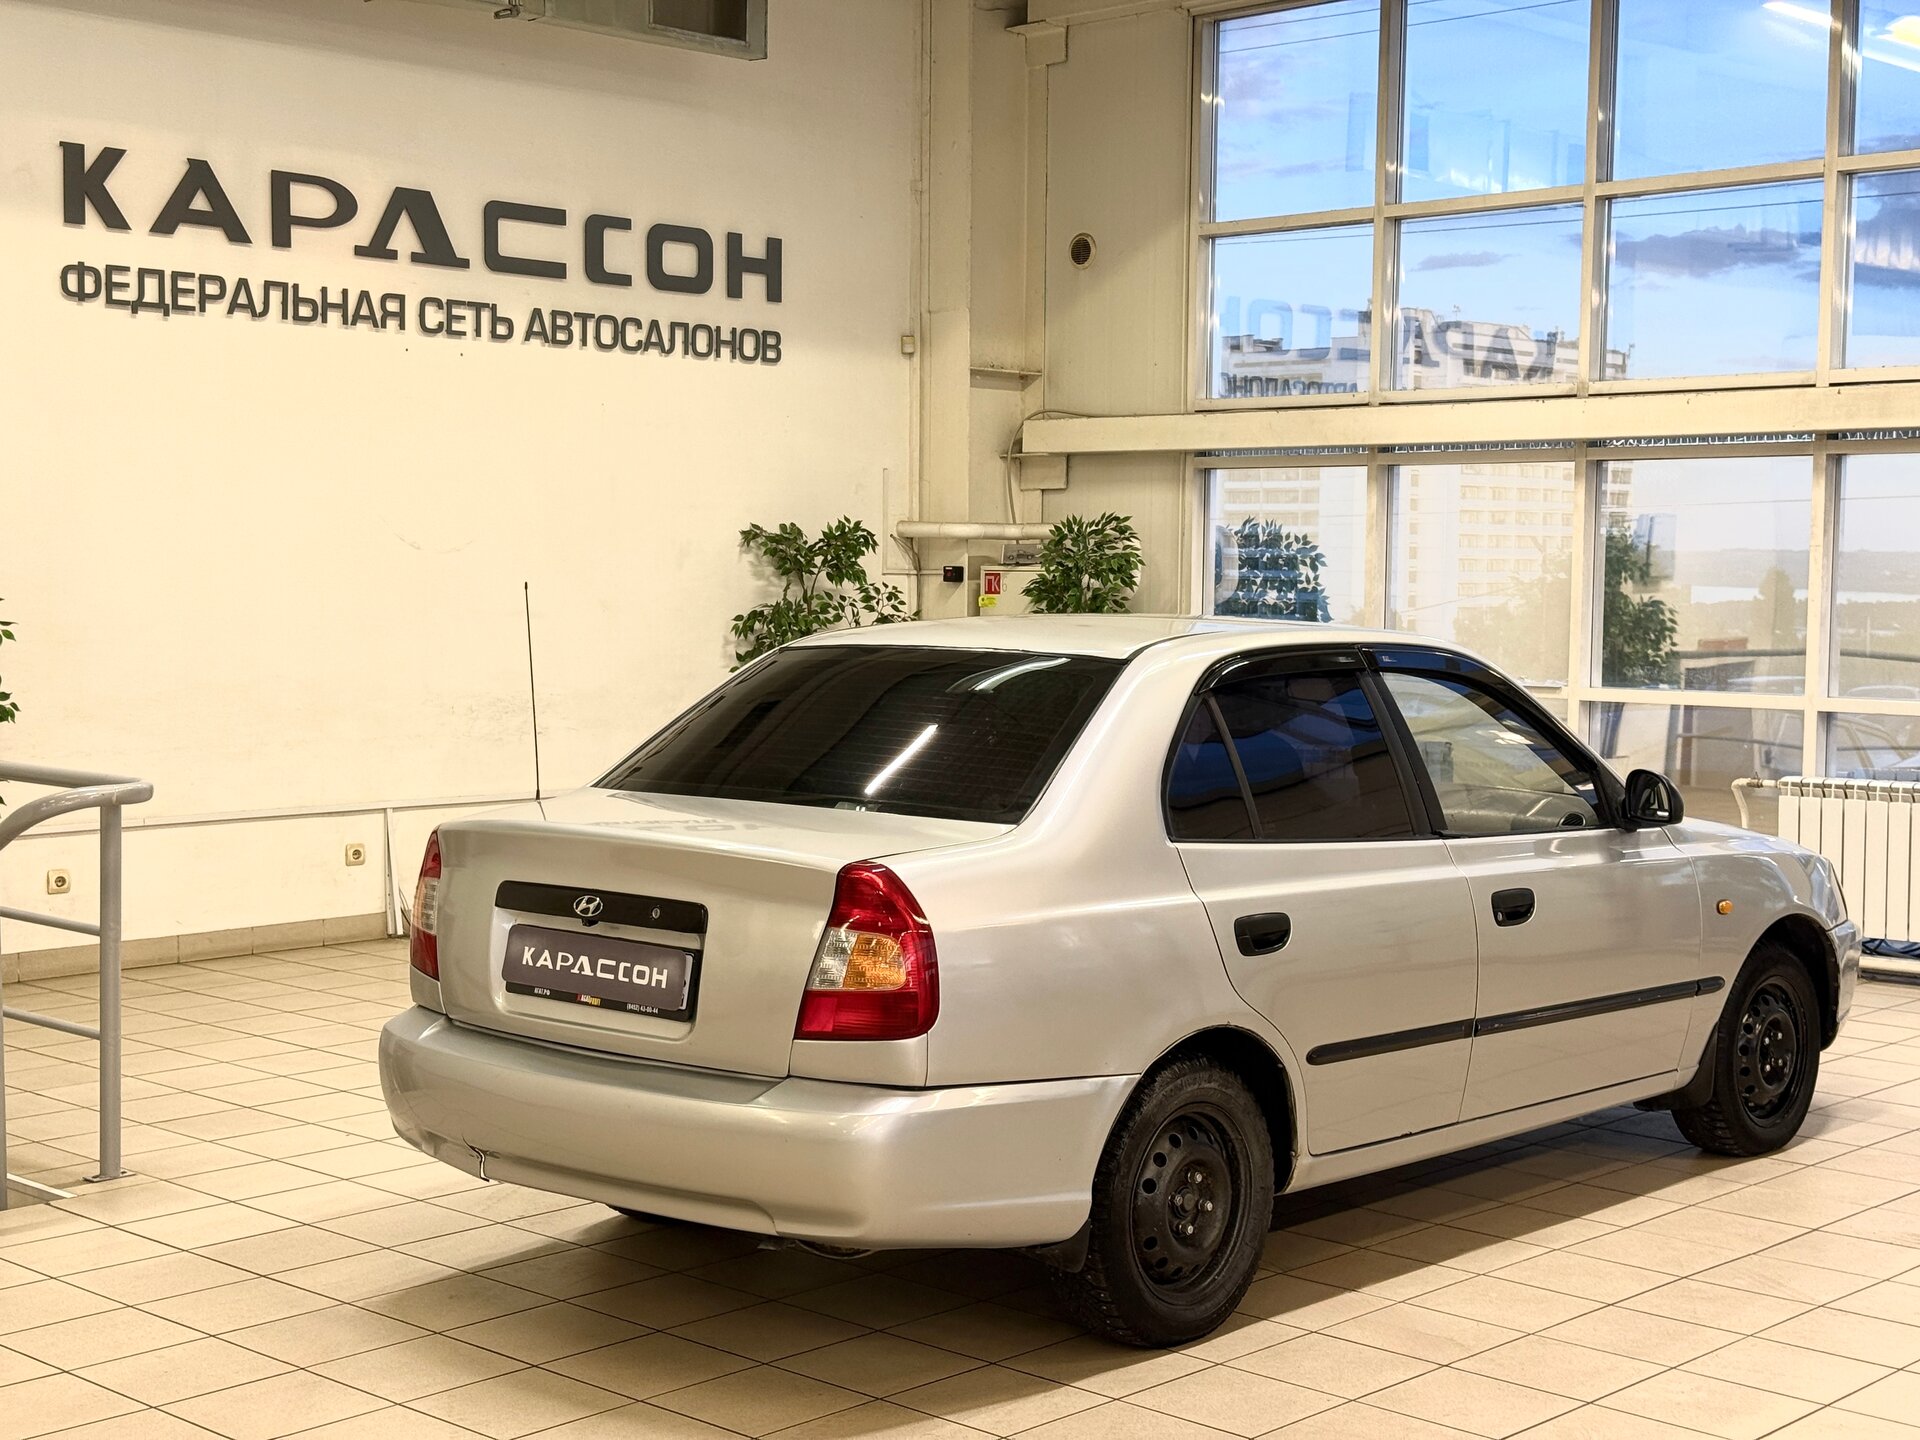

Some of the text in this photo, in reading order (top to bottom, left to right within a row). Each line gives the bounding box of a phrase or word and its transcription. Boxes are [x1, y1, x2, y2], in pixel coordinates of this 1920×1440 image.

[61, 261, 783, 364] ФЕДЕРАЛЬНАЯ СЕТЬ АВТОСАЛОНОВ
[985, 575, 1000, 592] ПК
